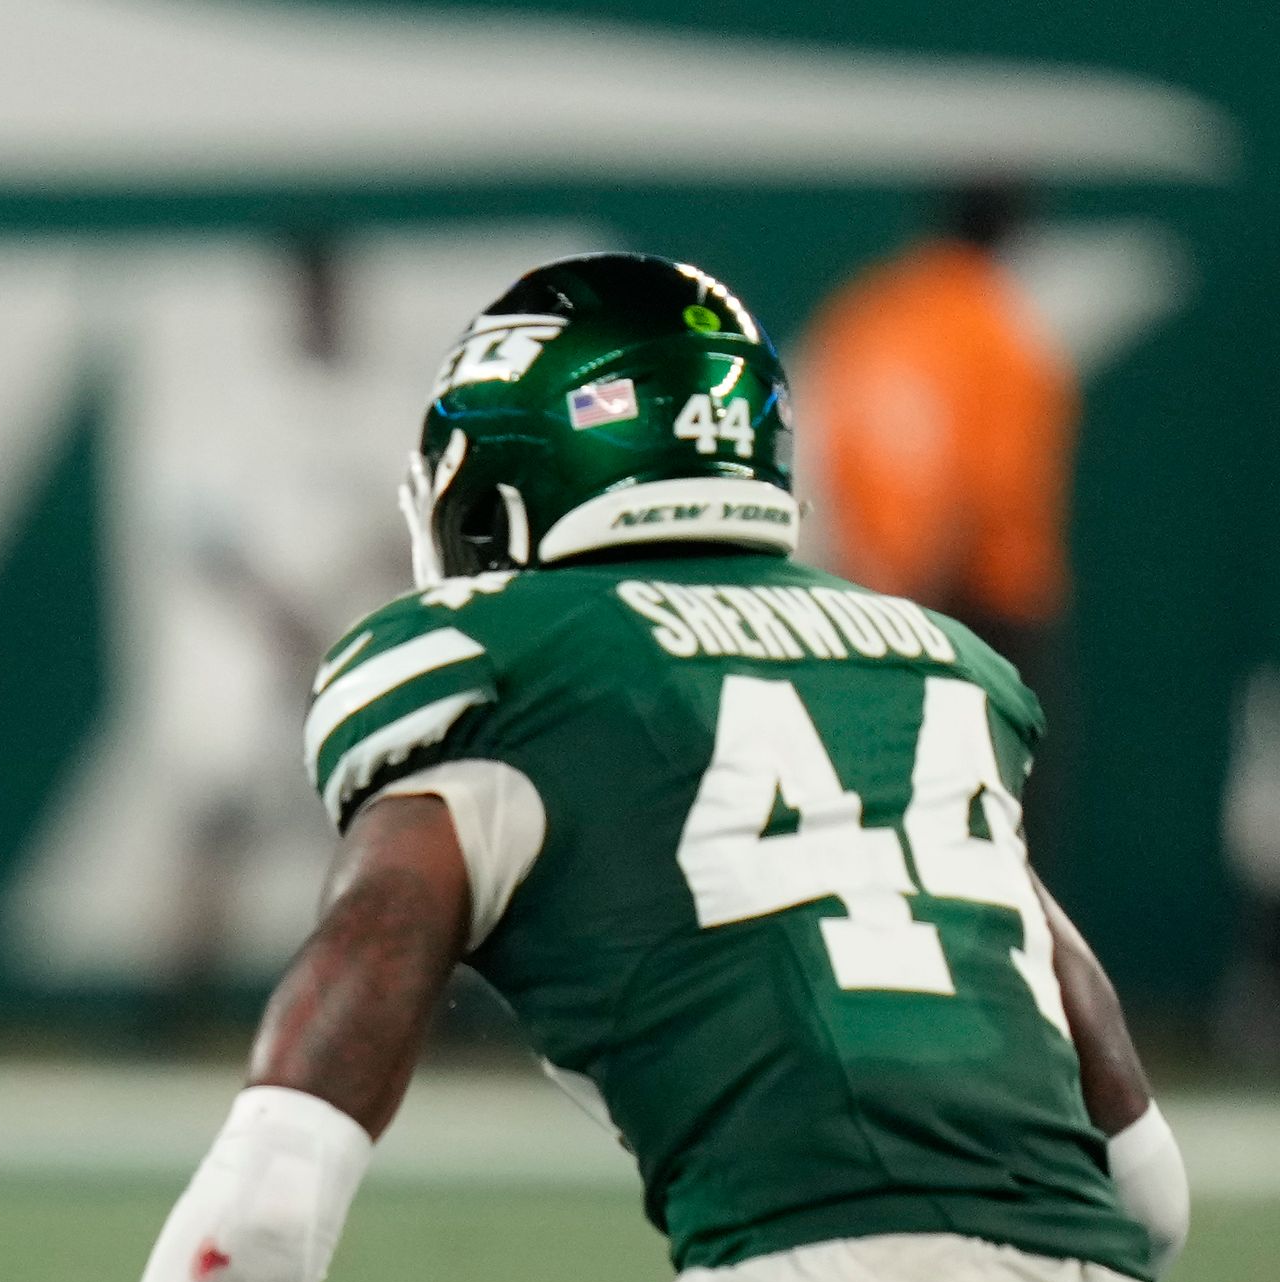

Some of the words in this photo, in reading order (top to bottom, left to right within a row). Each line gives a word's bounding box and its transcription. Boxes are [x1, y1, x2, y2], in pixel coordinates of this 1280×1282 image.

[673, 393, 755, 459] 44
[610, 503, 710, 529] NEW
[721, 503, 791, 526] YORK
[617, 580, 957, 662] SHERWOOD
[677, 675, 1072, 1042] 44
